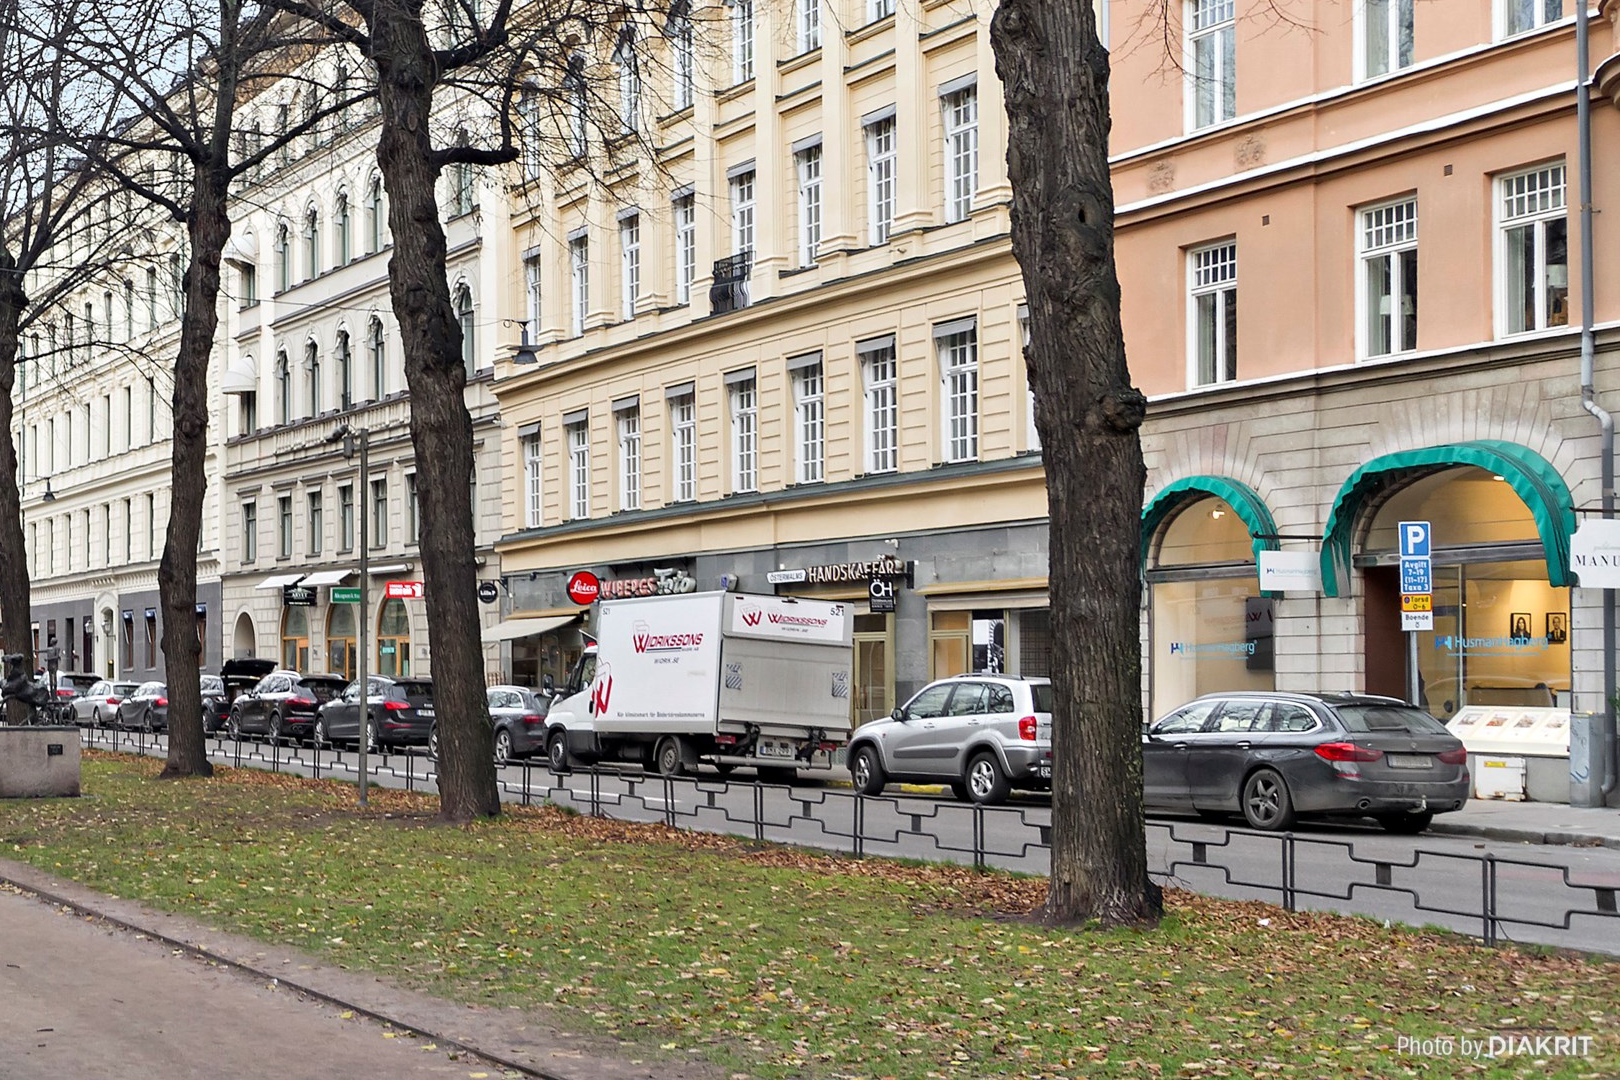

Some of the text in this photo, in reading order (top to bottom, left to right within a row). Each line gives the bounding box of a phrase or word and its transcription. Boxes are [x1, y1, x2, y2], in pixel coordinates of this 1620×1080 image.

[1406, 525, 1426, 555] P
[1404, 561, 1427, 571] Avgift
[570, 579, 597, 595] Leica
[601, 577, 656, 599] WIBERGS
[870, 578, 893, 597] ÖH
[767, 612, 828, 626] WIDRIKSSONS
[830, 607, 845, 617] 521
[633, 633, 704, 654] WIDRIKSSONS
